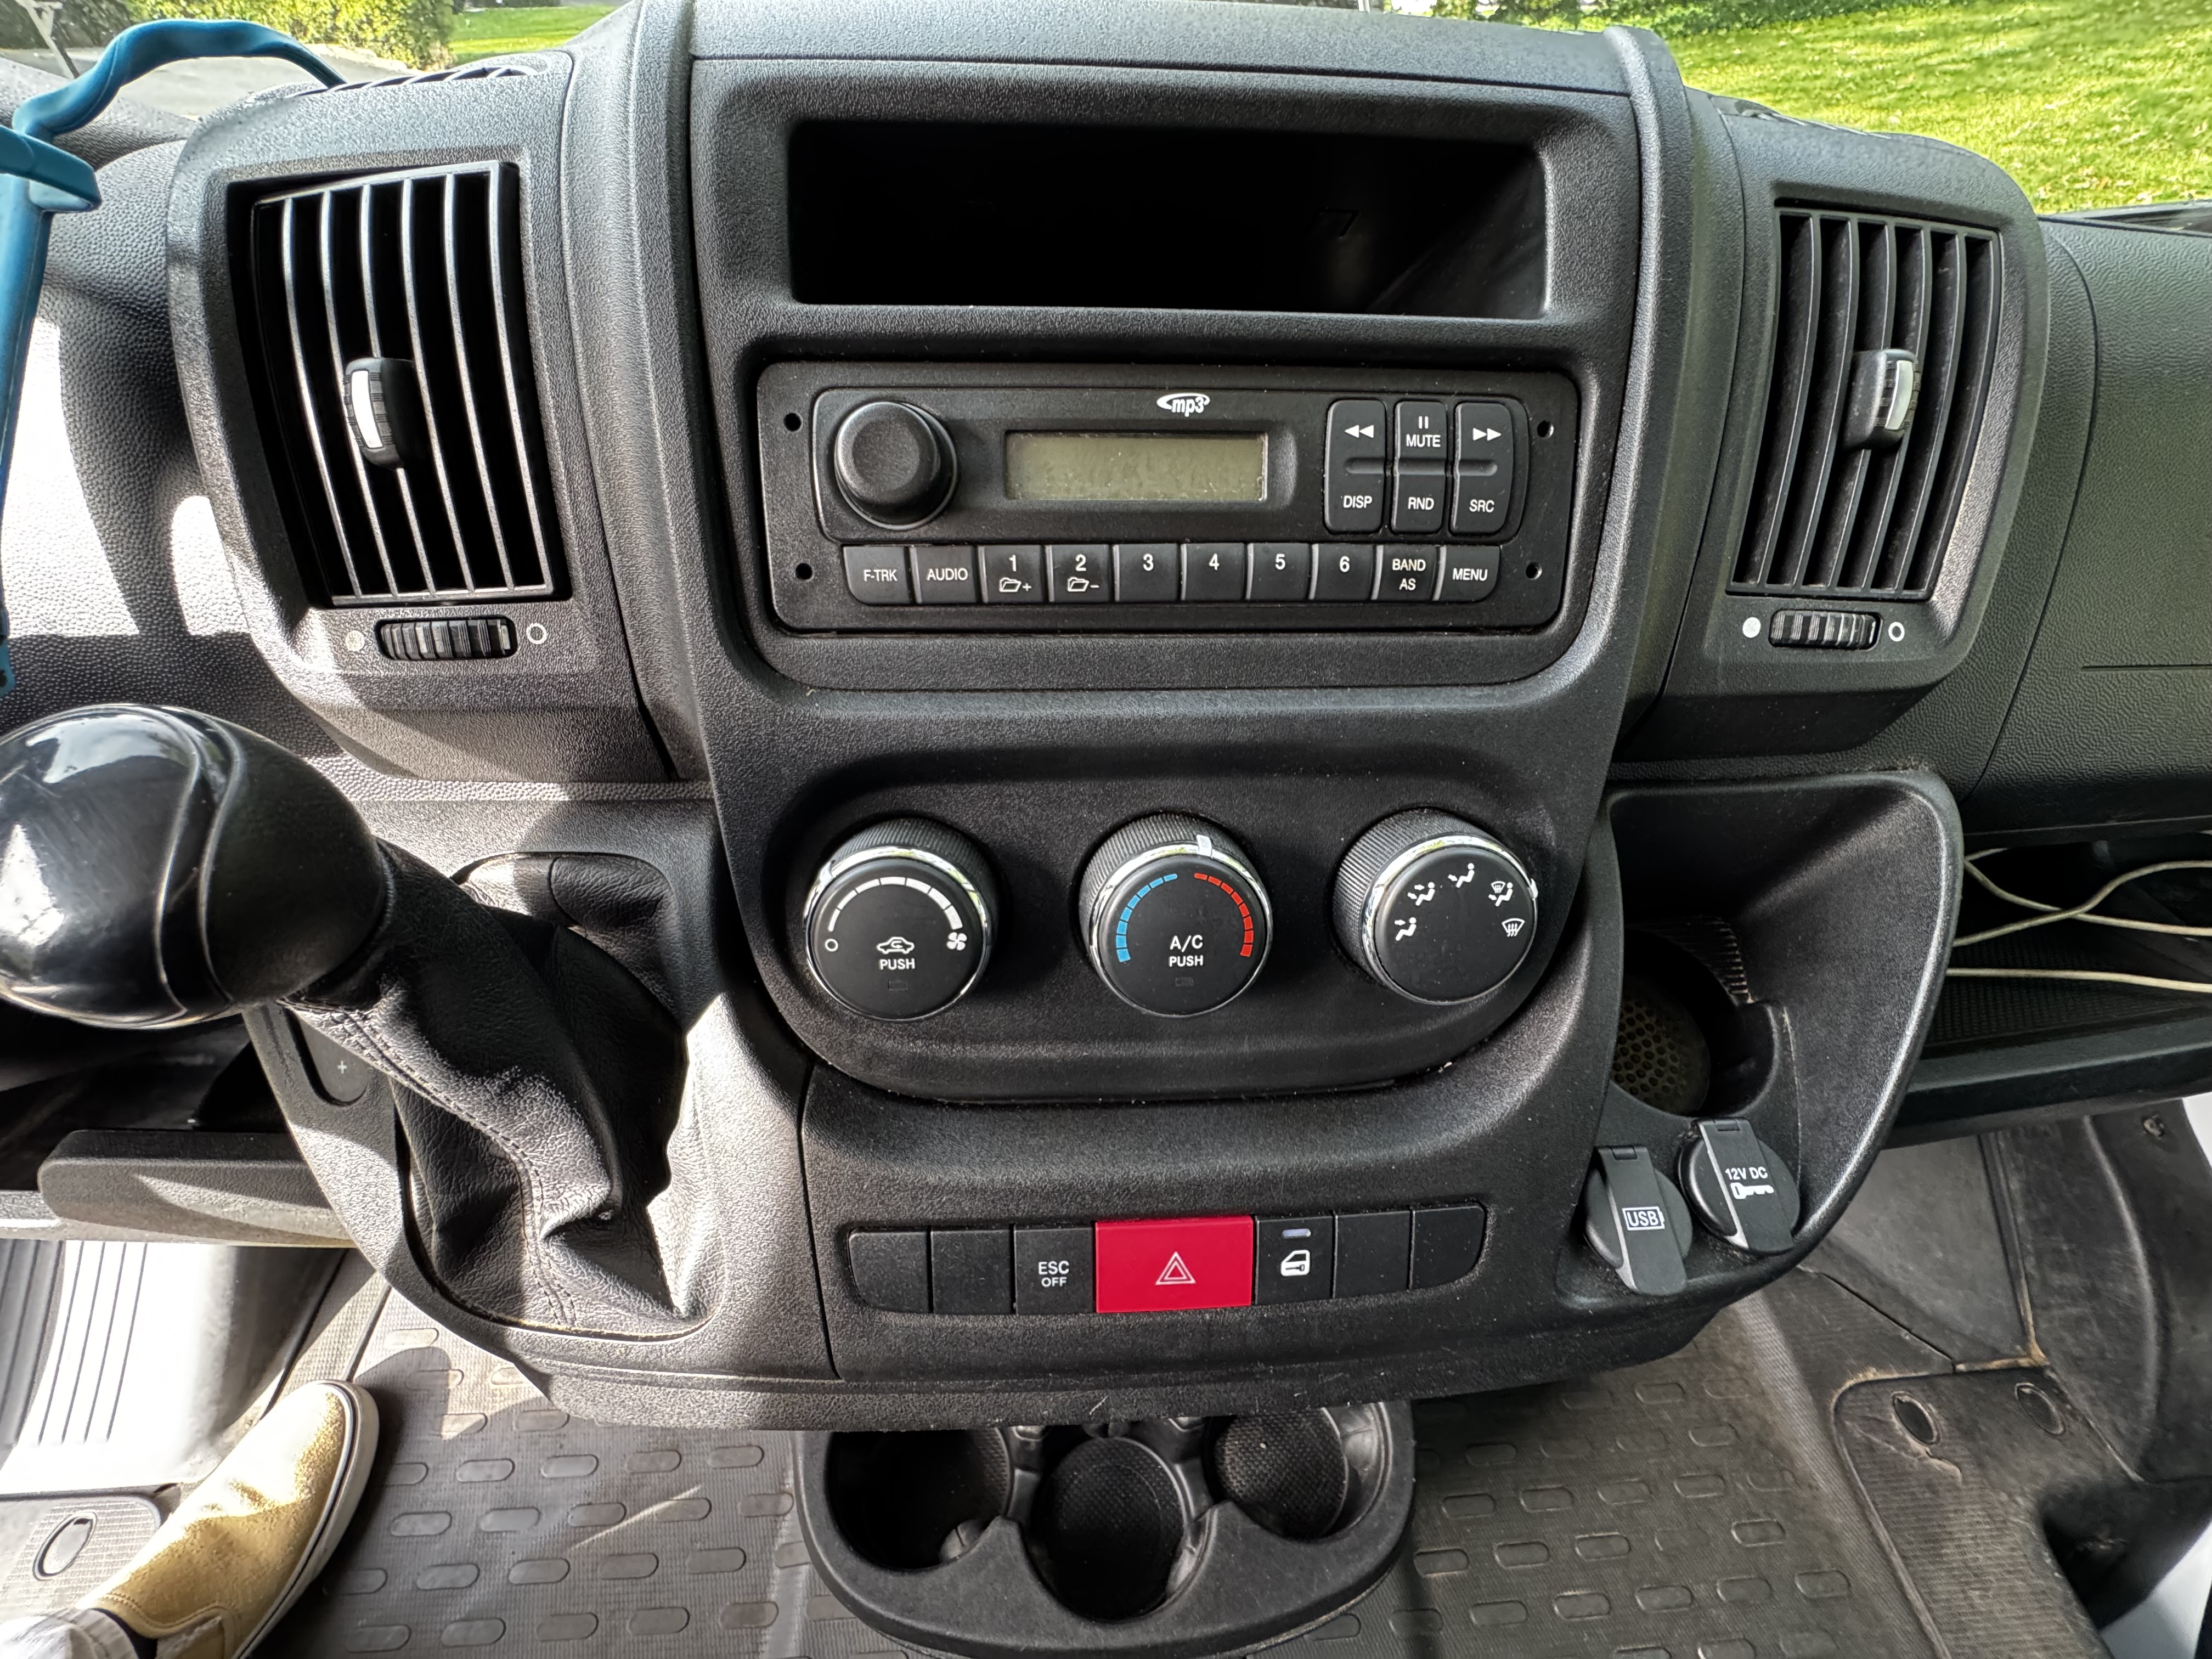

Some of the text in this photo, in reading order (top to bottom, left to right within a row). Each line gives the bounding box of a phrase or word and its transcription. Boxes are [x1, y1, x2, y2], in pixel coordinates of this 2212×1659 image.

[1171, 395, 1206, 417] mp3
[1406, 433, 1441, 448] MUTE
[1343, 495, 1373, 509] DISP
[1408, 496, 1435, 510] RND
[1469, 499, 1495, 513] SRC
[1009, 554, 1017, 572] 1
[1075, 554, 1087, 572] 2
[1143, 552, 1154, 571] 3
[1209, 553, 1220, 571] 4
[1275, 553, 1286, 570] 5
[1339, 556, 1350, 572] 6
[1392, 558, 1426, 572] BAND
[862, 567, 898, 582] F-TRK
[926, 567, 968, 581] AUDIO
[1452, 568, 1488, 582] MENU
[1399, 578, 1416, 591] AS
[1170, 934, 1203, 952] A/C
[879, 958, 915, 970] PUSH
[1169, 955, 1204, 967] PUSH
[1725, 1166, 1769, 1181] 12V DC
[1627, 1211, 1659, 1227] USB
[1038, 1260, 1069, 1275] ESC
[1041, 1277, 1067, 1287] OFF
